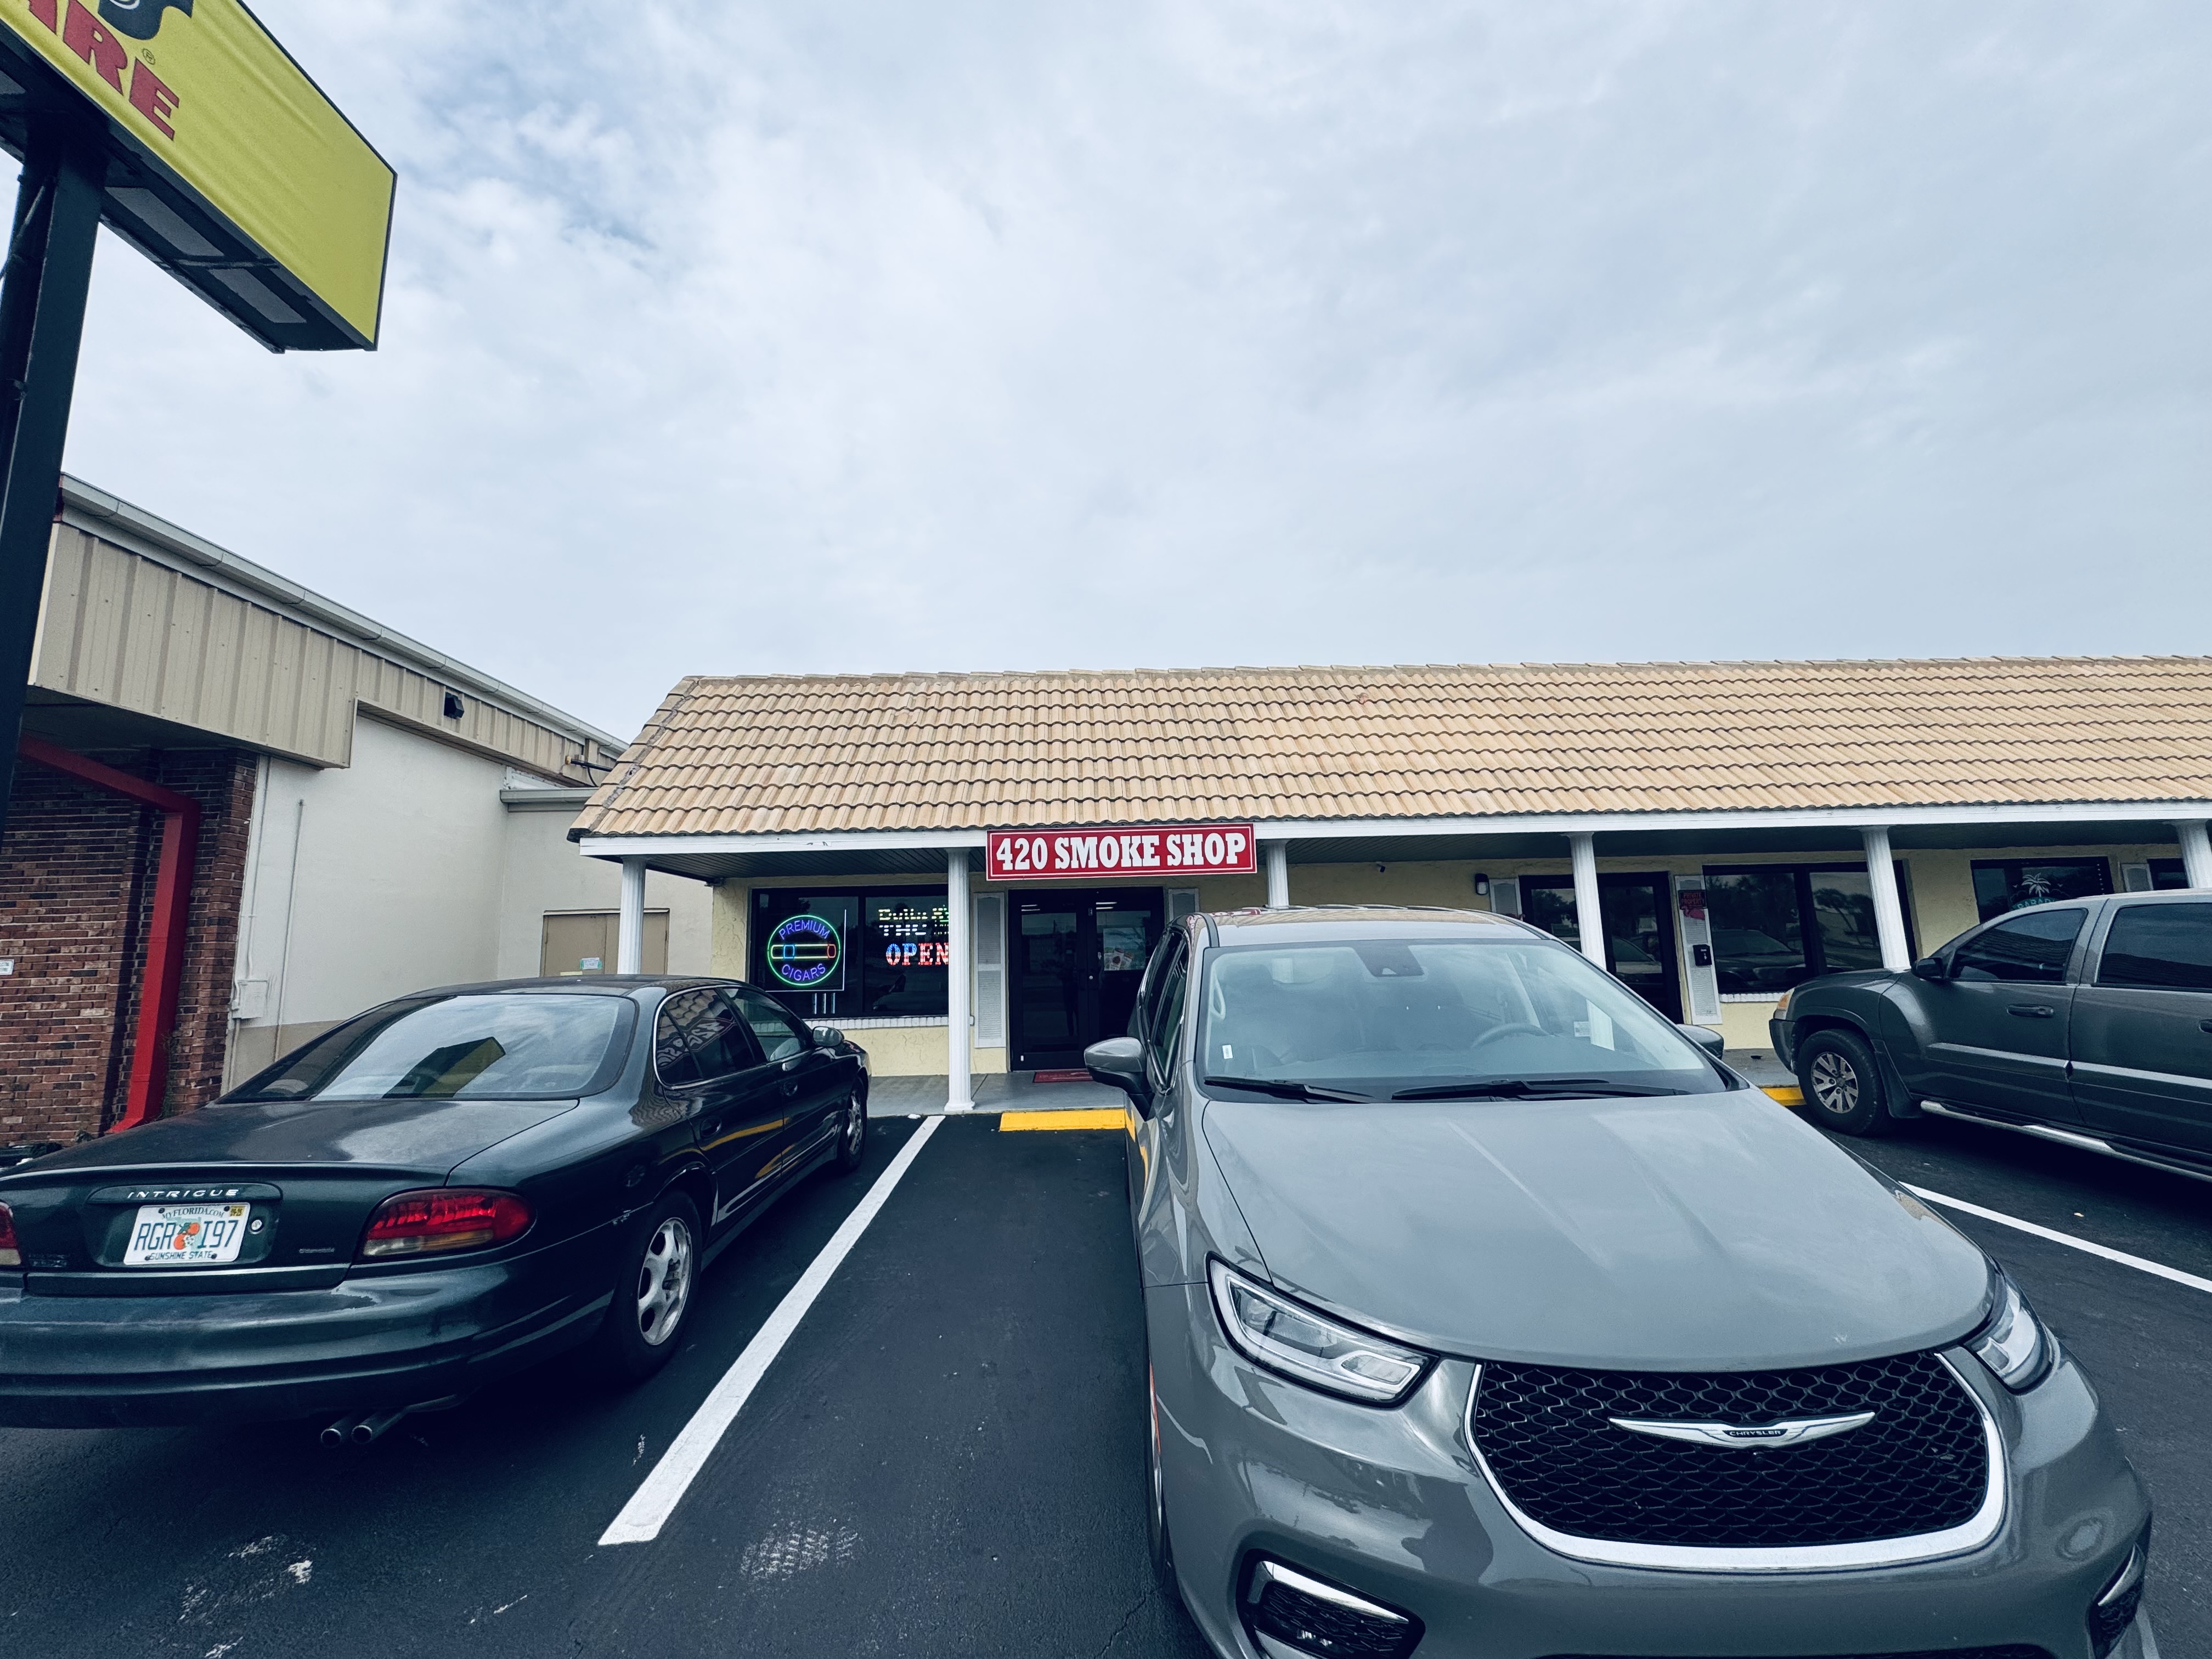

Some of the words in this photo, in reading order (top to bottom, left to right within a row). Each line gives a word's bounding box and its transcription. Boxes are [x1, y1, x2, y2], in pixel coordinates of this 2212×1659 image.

[996, 837, 1048, 871] 420
[1054, 835, 1160, 870] SMOKE
[1166, 832, 1246, 866] SHOP
[778, 919, 830, 940] PREMIUM
[885, 942, 949, 966] OPEN
[781, 963, 826, 981] CIGARS
[127, 1189, 239, 1198] INTRIGUE
[161, 1207, 225, 1219] MYFLORIDA.COM
[134, 1222, 177, 1251] RGR
[149, 1251, 187, 1260] SUNSHINE
[189, 1251, 212, 1259] STATE
